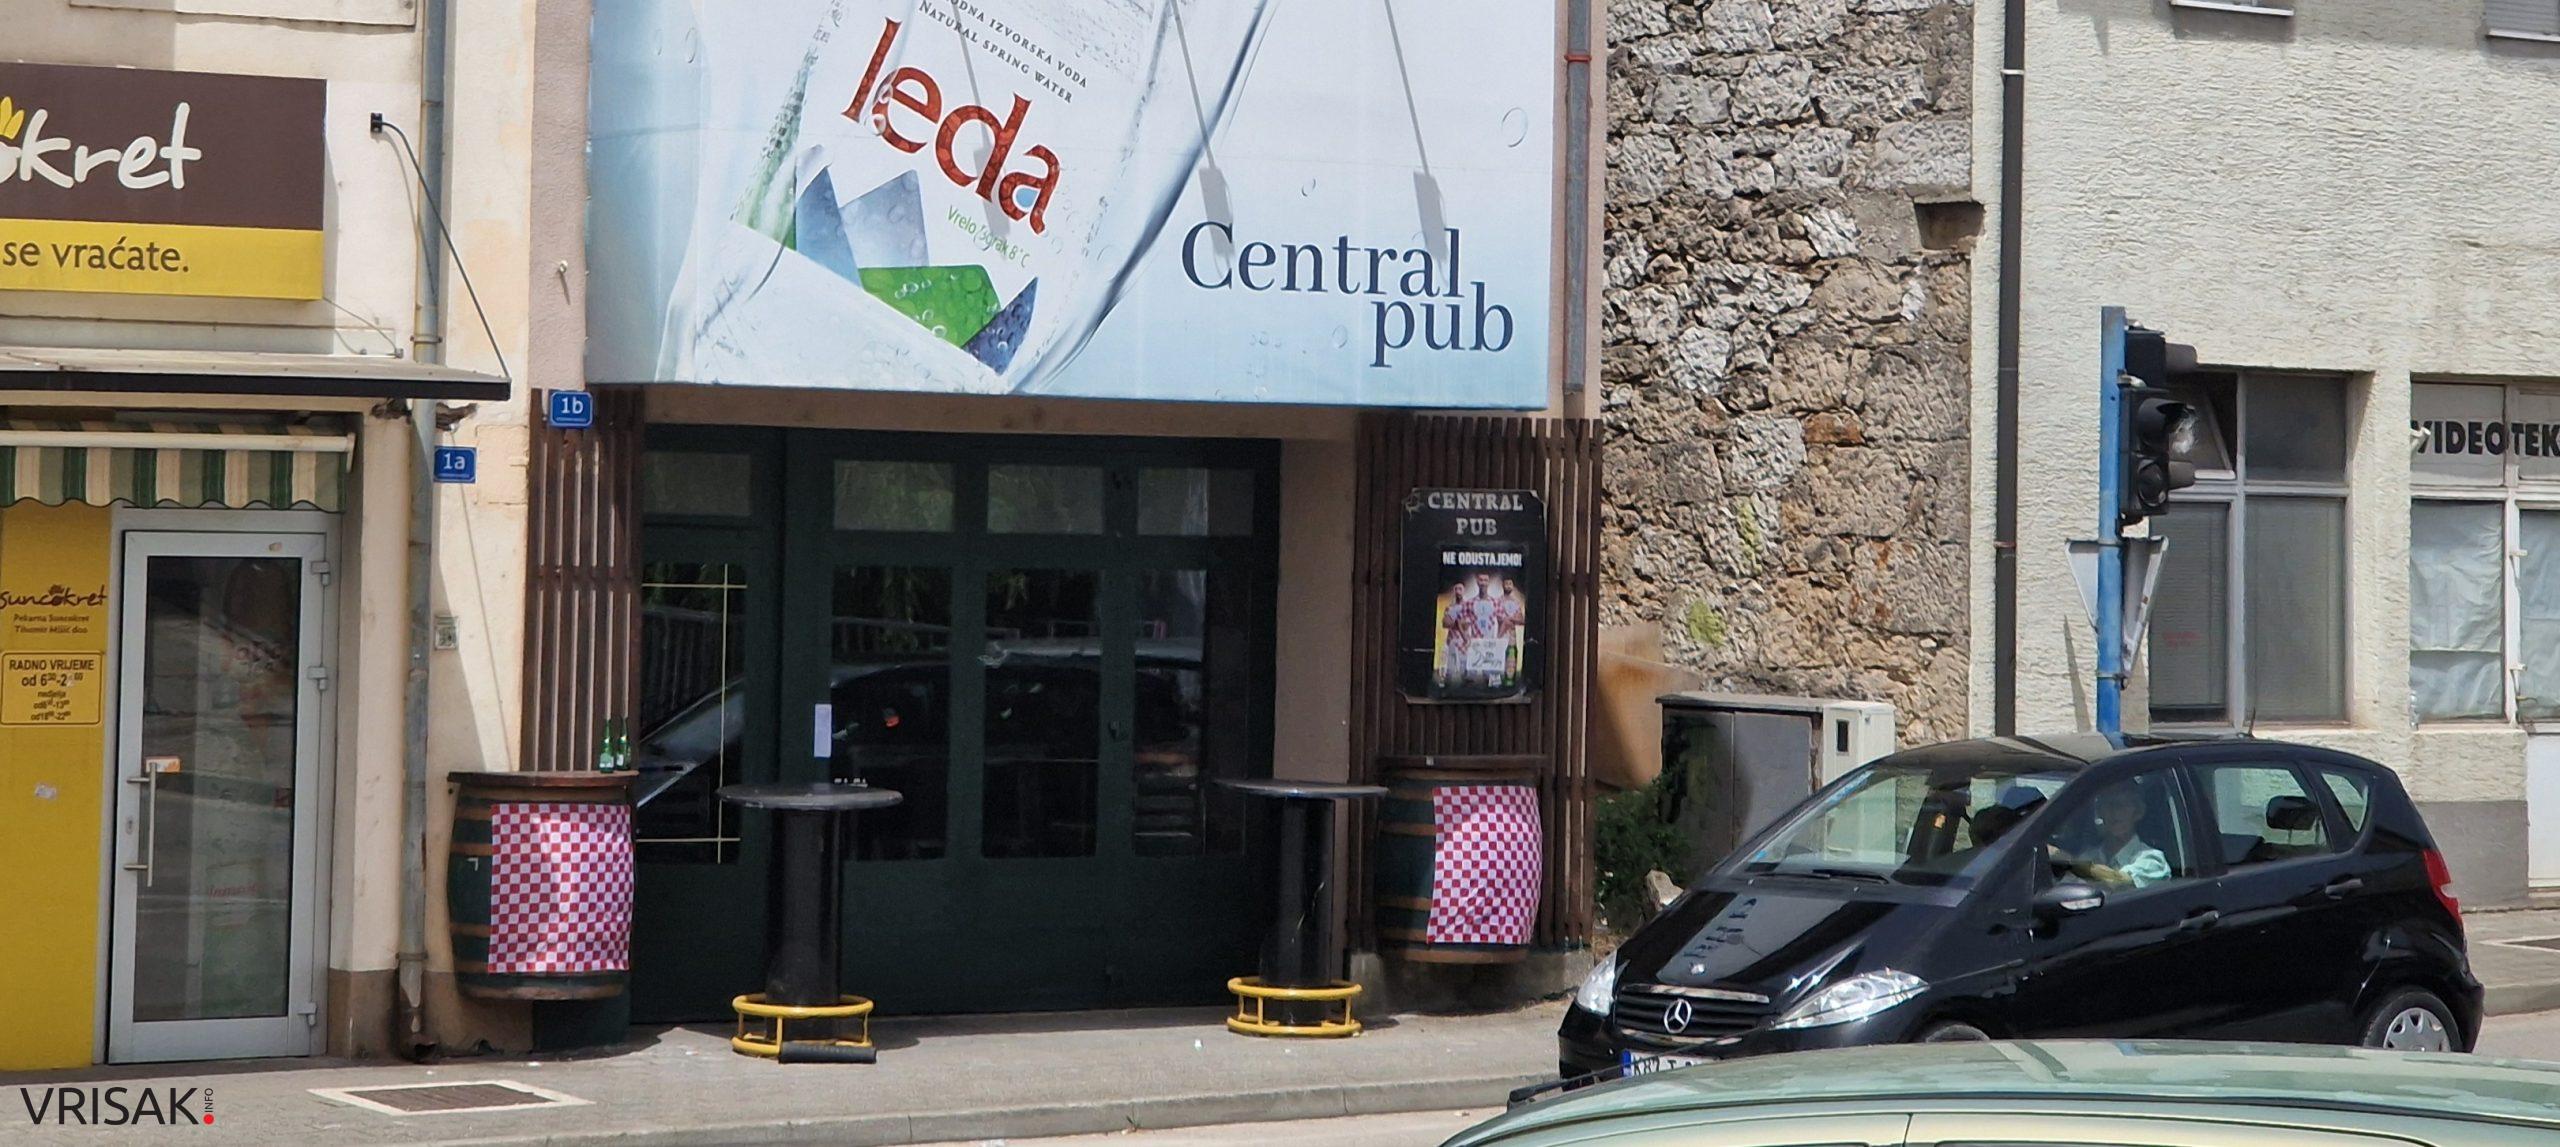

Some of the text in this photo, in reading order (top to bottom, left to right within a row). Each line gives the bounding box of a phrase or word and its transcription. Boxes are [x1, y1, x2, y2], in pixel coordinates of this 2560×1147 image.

[989, 18, 1053, 65] IZVORSKA
[1057, 60, 1088, 88] VODA
[983, 40, 1030, 74] SPRING
[1034, 70, 1074, 103] WATER
[841, 16, 1061, 234] leda
[946, 204, 977, 234] Vrelo
[2, 236, 189, 273] se vraćate.
[1182, 221, 1465, 298] Central
[1369, 281, 1514, 368] pub
[561, 397, 584, 414] 1b
[443, 453, 466, 470] 1a
[1428, 492, 1524, 511] CENTRAL
[1456, 517, 1497, 536] PUB
[1442, 551, 1457, 565] NE
[9, 659, 95, 671] RADNO VRIJEME
[21, 675, 37, 687] od
